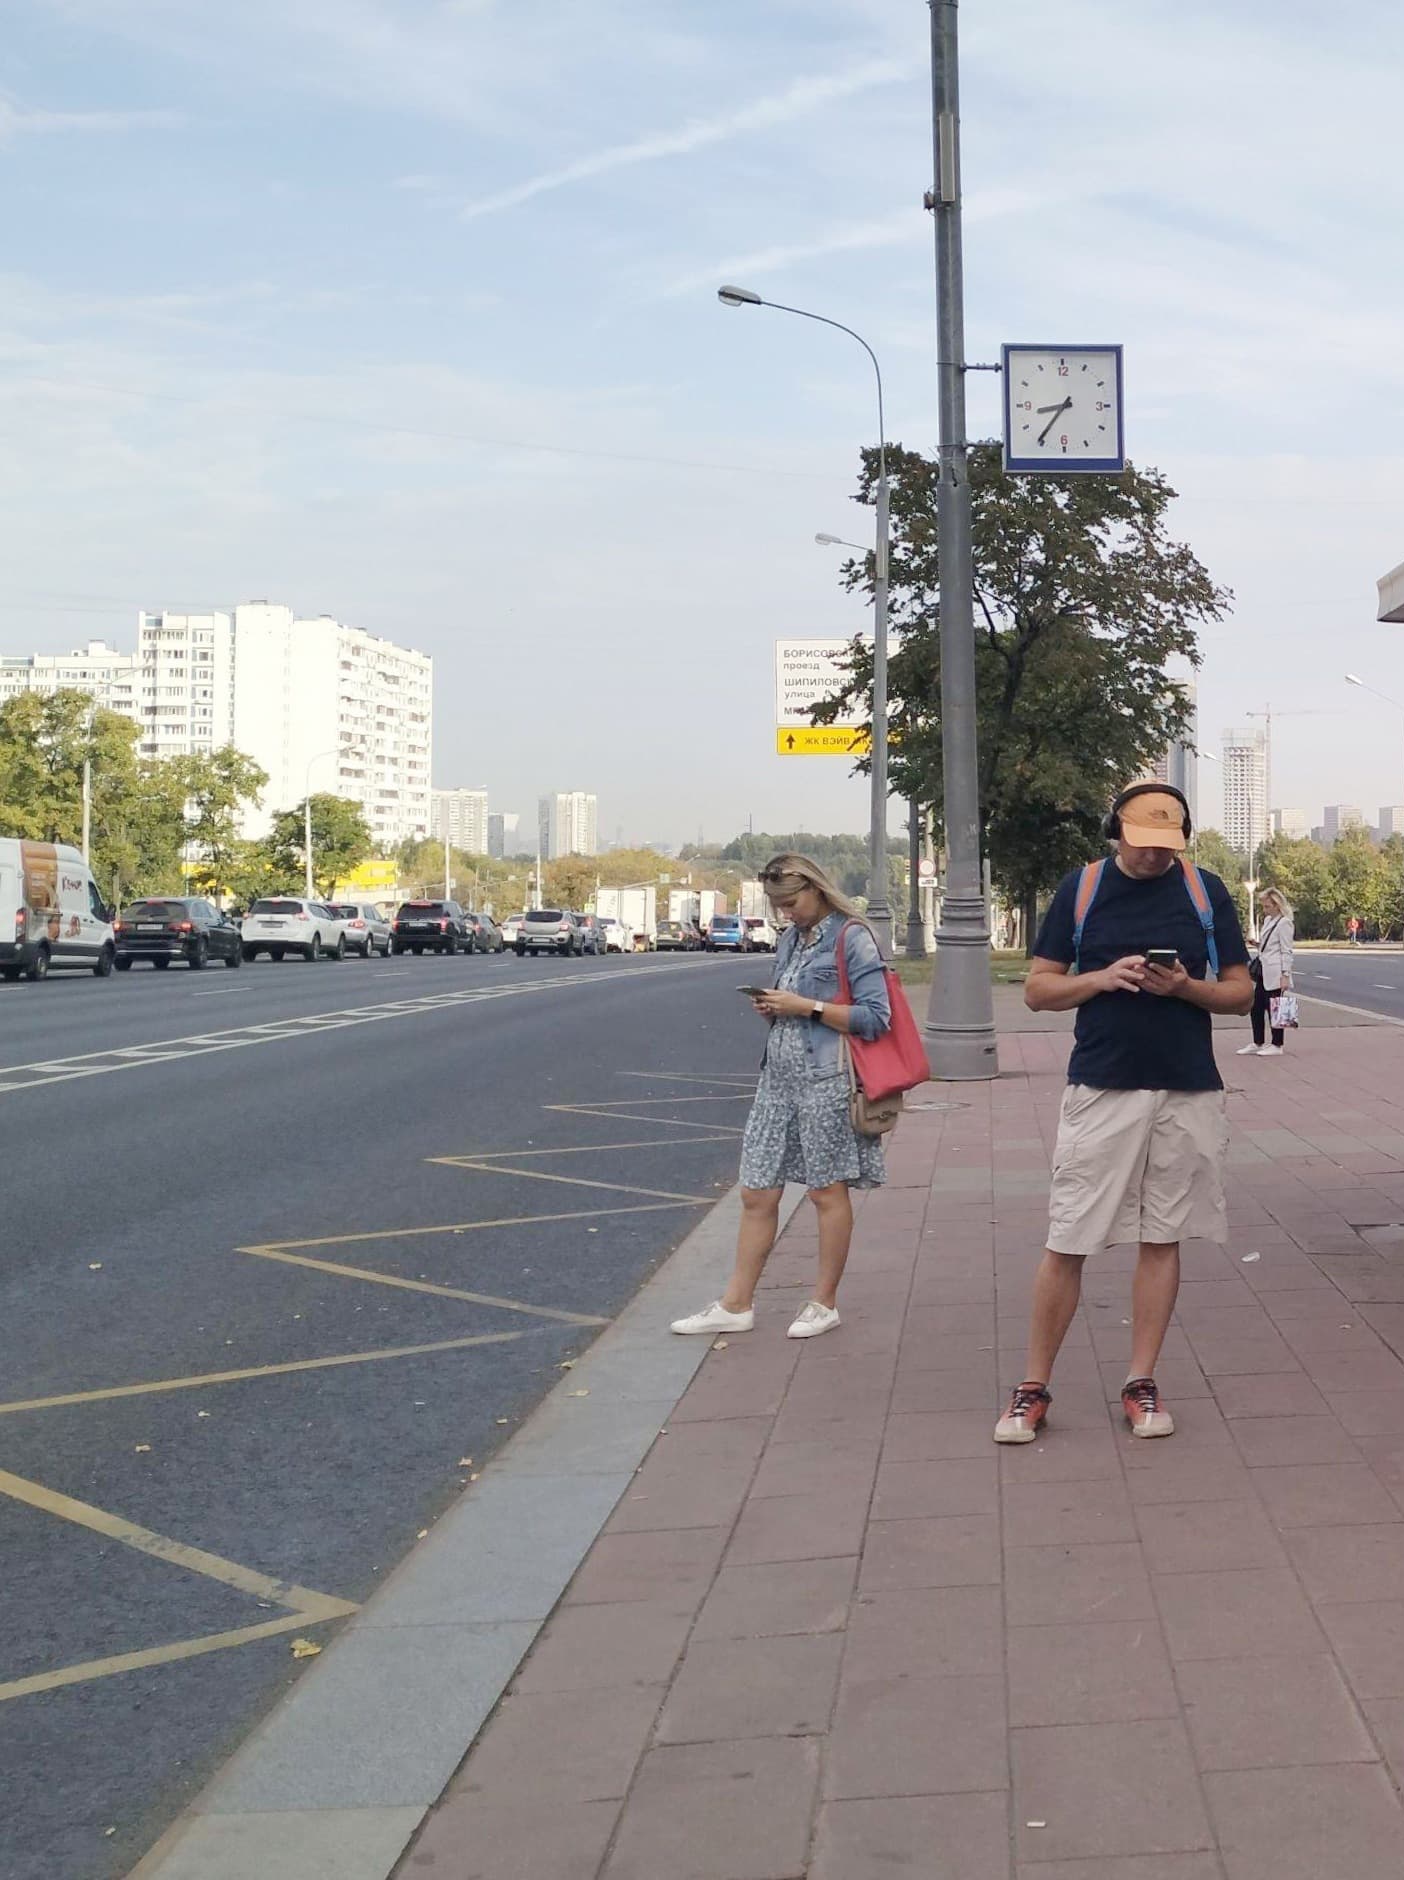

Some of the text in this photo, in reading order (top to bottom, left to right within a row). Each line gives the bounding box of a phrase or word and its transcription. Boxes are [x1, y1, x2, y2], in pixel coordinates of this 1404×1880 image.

[1058, 366, 1069, 376] 12
[1025, 401, 1031, 411] 9
[1096, 401, 1103, 411] 3
[1060, 435, 1068, 445] 6
[785, 691, 815, 699] улица
[805, 737, 819, 745] ЖК
